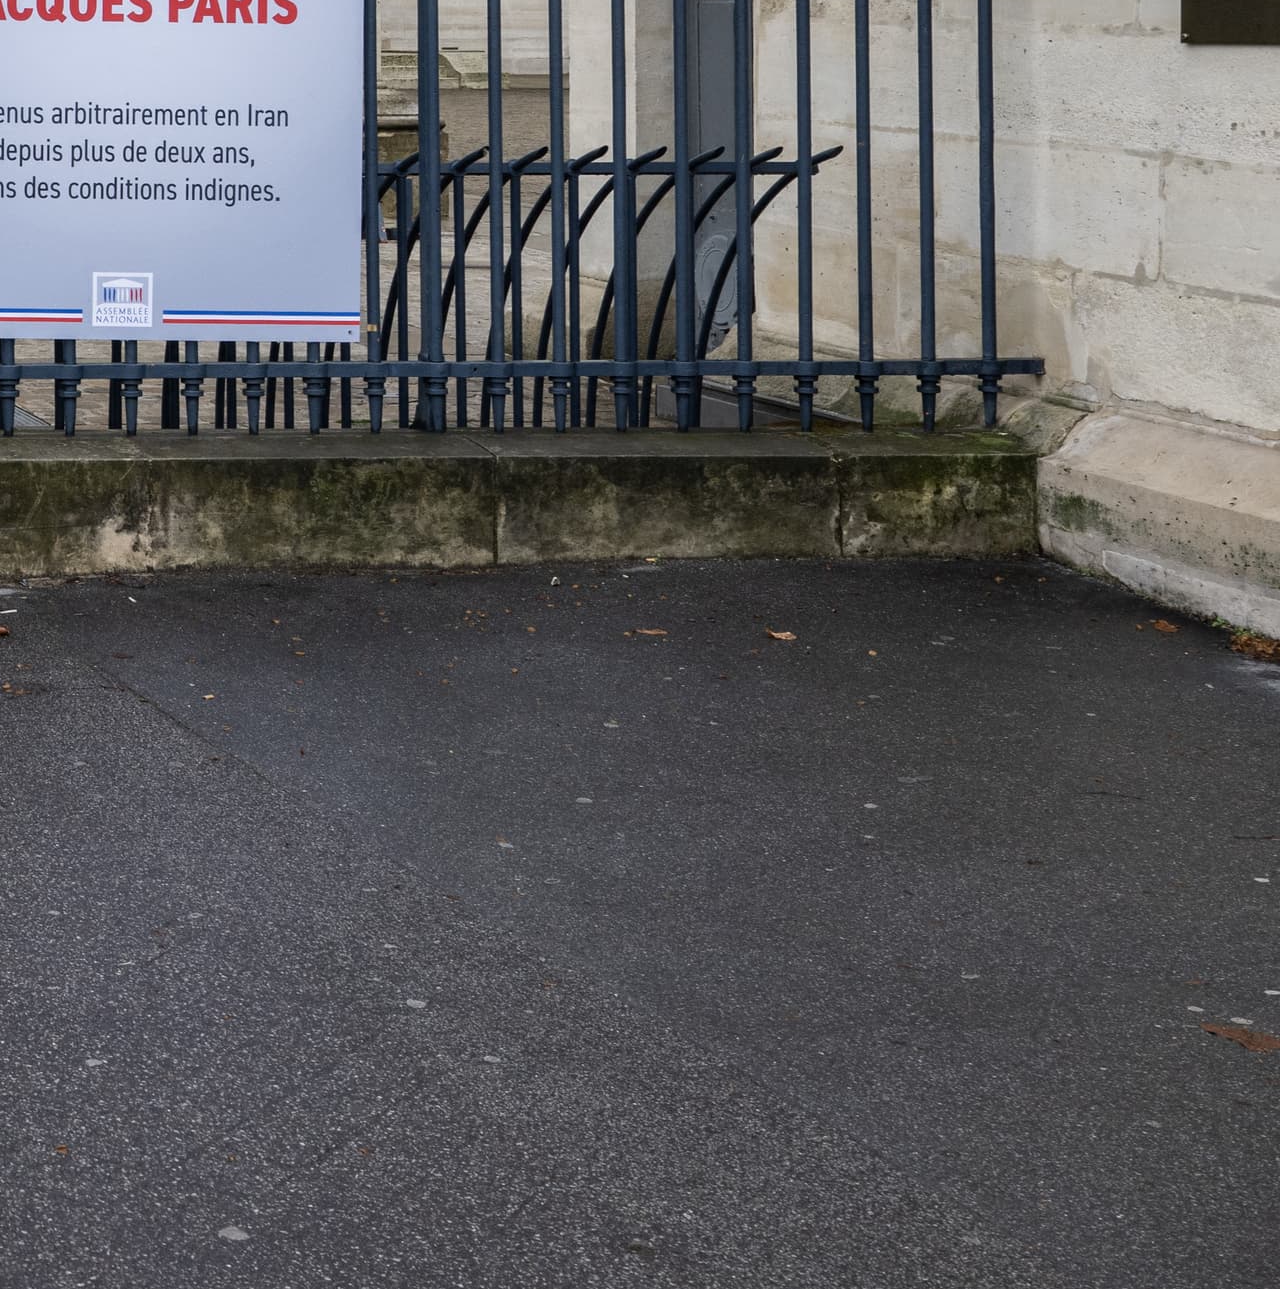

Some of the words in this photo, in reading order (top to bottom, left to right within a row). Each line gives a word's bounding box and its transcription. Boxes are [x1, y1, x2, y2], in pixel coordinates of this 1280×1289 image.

[51, 101, 208, 126] arbitrairement
[214, 108, 239, 127] en
[248, 103, 289, 127] Iran
[71, 138, 116, 168] plus
[122, 139, 148, 163] de
[154, 139, 206, 164] deux
[212, 146, 255, 168] ans,
[24, 175, 61, 199] des
[68, 176, 177, 201] conditions
[185, 177, 281, 208] indignes.
[96, 316, 149, 324] NATIONALE
